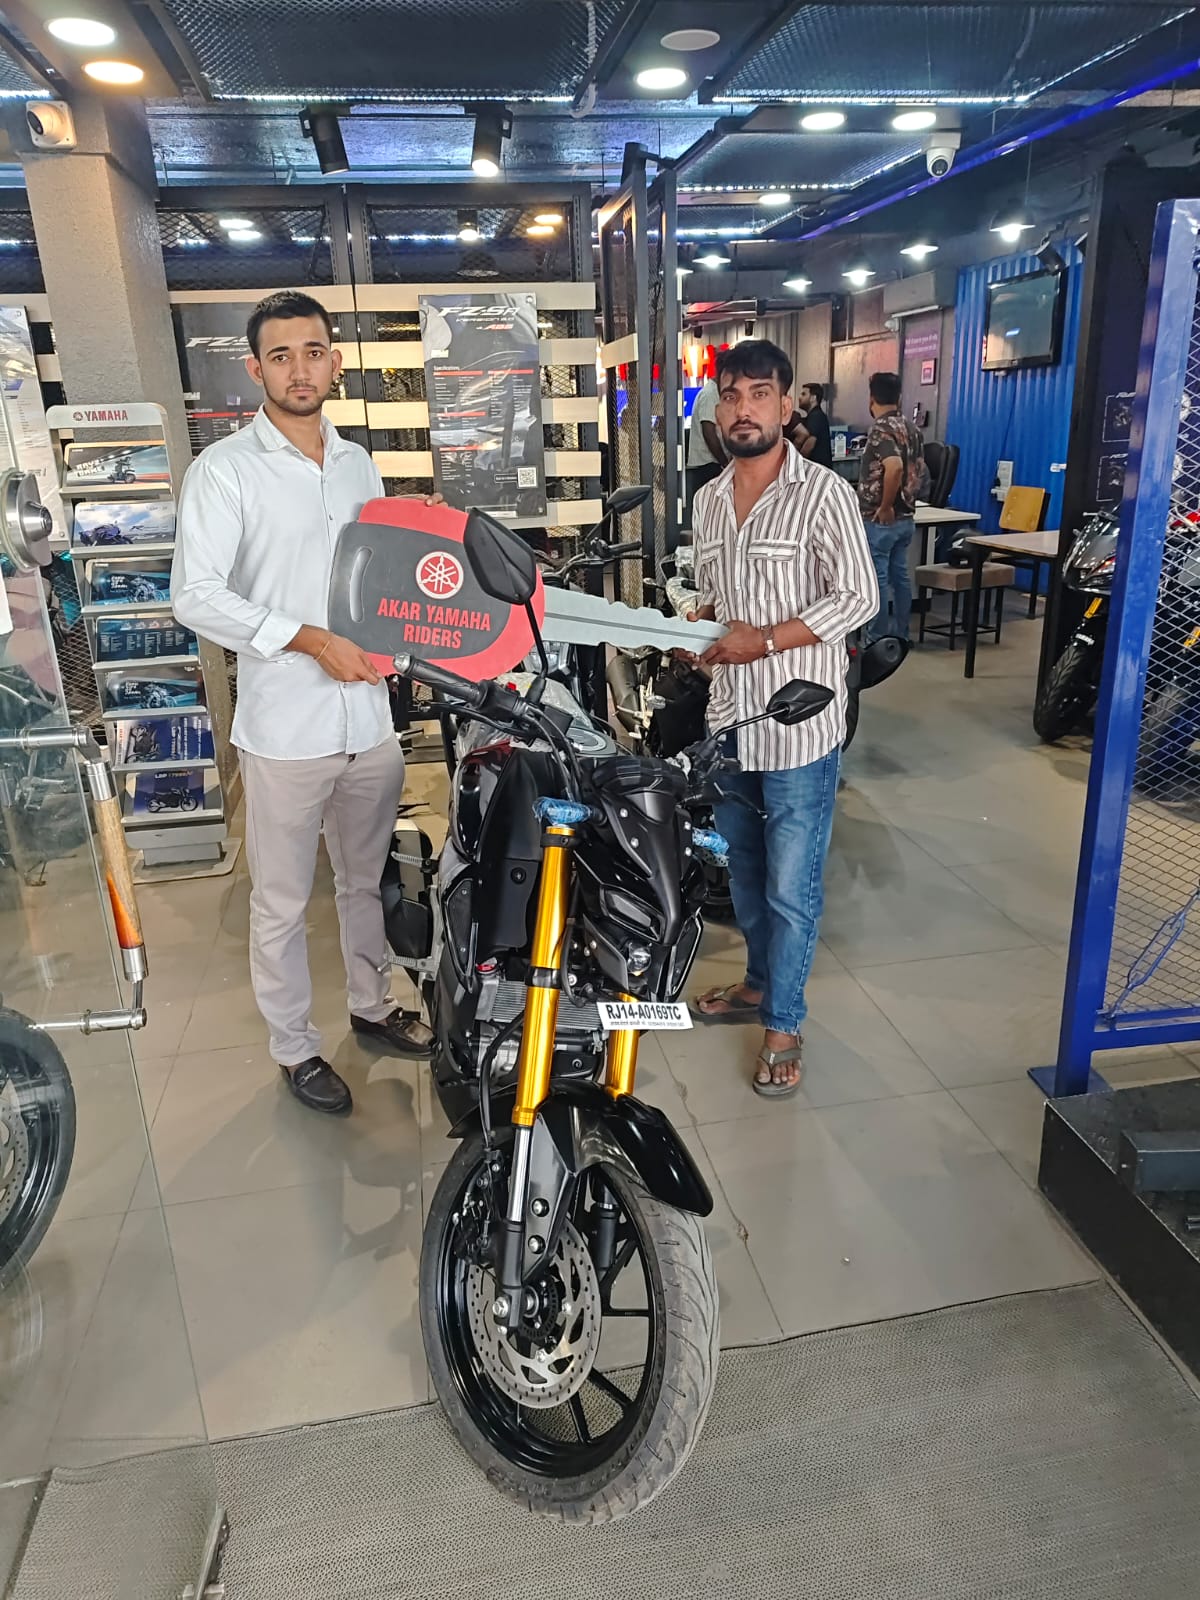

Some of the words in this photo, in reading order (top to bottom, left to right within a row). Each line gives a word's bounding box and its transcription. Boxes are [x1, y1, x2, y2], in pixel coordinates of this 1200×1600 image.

[84, 409, 129, 422] YAMAHA
[377, 597, 421, 622] AKAR
[426, 604, 491, 631] YAMAHA
[403, 623, 462, 649] RIDERS
[605, 1004, 682, 1020] RJ14-A0169TC
